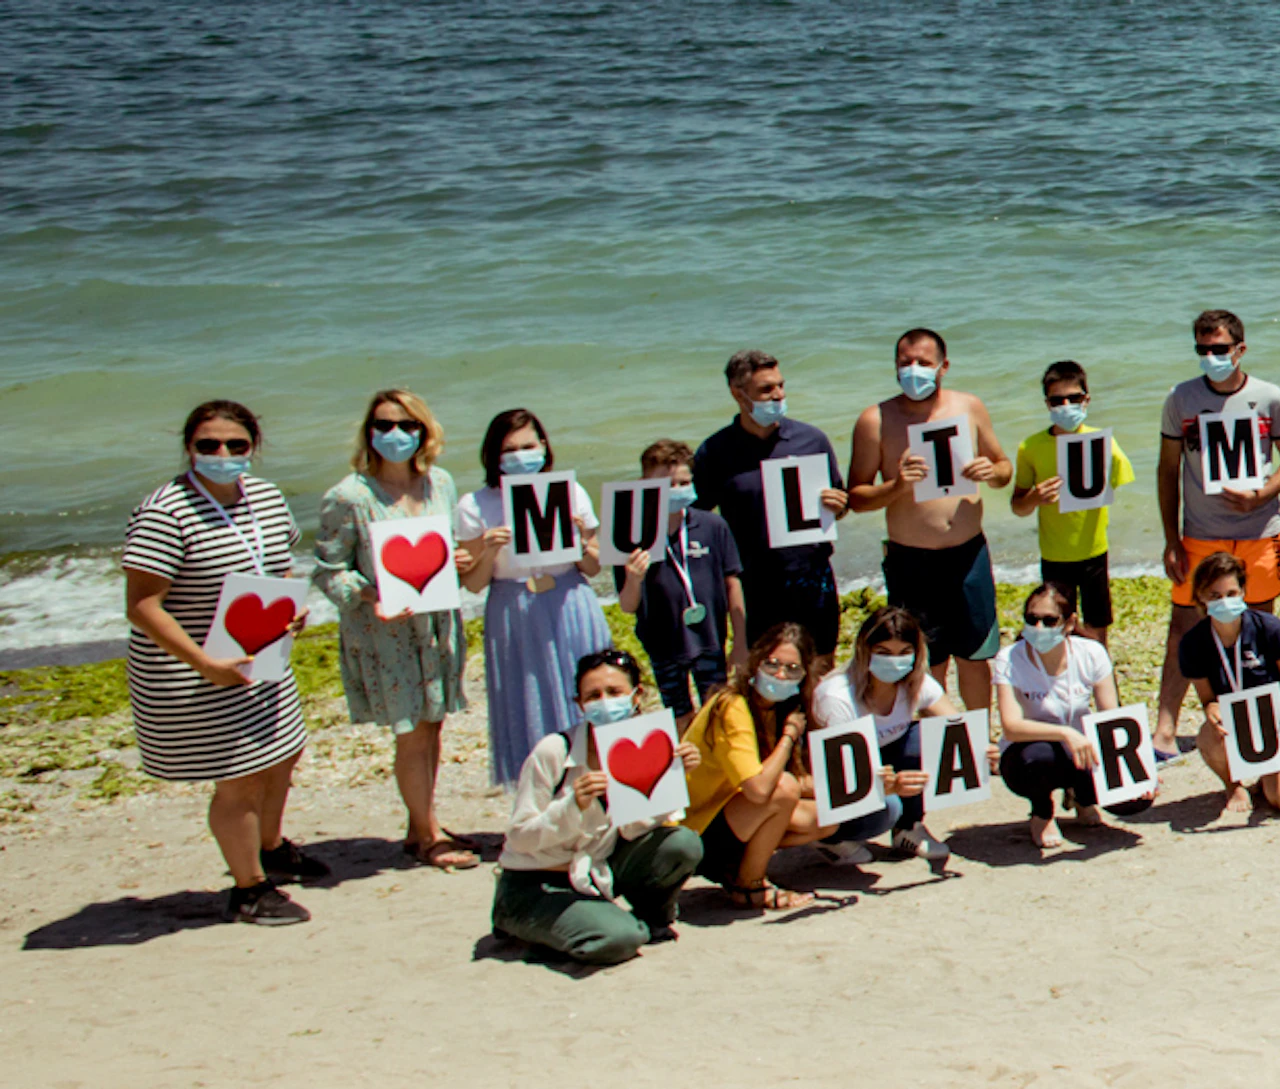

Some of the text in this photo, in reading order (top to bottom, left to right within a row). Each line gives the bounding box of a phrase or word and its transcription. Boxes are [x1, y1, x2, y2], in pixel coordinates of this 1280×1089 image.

[1067, 437, 1105, 499] U
[1206, 418, 1256, 481] M
[511, 481, 574, 554] M
[612, 487, 660, 554] U
[782, 467, 822, 532] L
[1096, 718, 1149, 790] R
[1231, 694, 1278, 763] U
[823, 733, 872, 809] D
